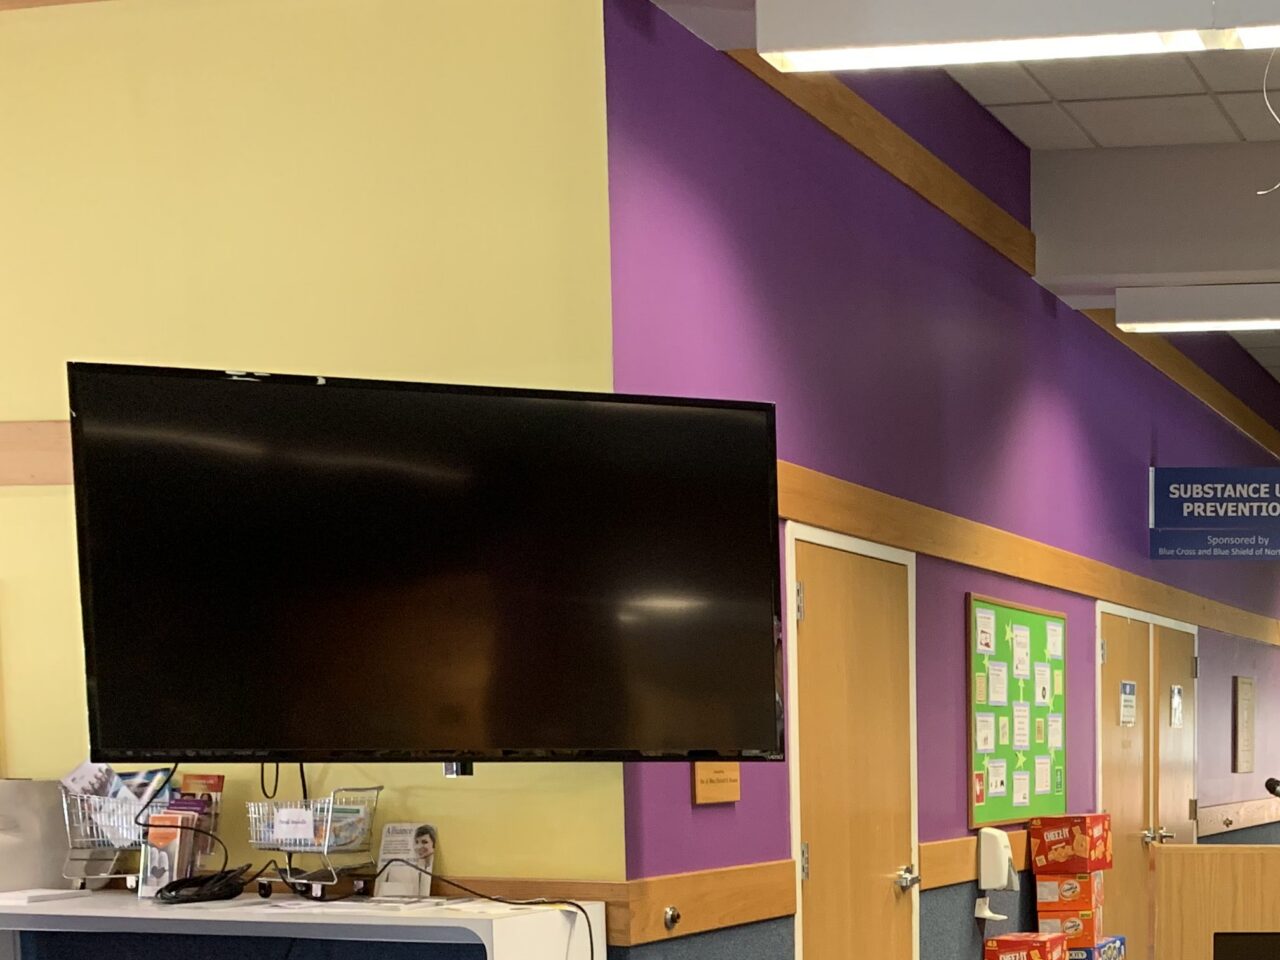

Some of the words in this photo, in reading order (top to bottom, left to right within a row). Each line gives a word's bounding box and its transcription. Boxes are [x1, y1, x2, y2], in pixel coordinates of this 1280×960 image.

[1169, 483, 1270, 498] SUBSTANCE
[1207, 535, 1255, 546] Sponsored
[1258, 535, 1270, 546] by
[1158, 547, 1175, 556] Blue
[1176, 547, 1196, 556] Cross
[1198, 547, 1212, 556] and
[1213, 547, 1230, 556] Blue
[1231, 547, 1254, 556] Shield
[1255, 547, 1264, 556] of
